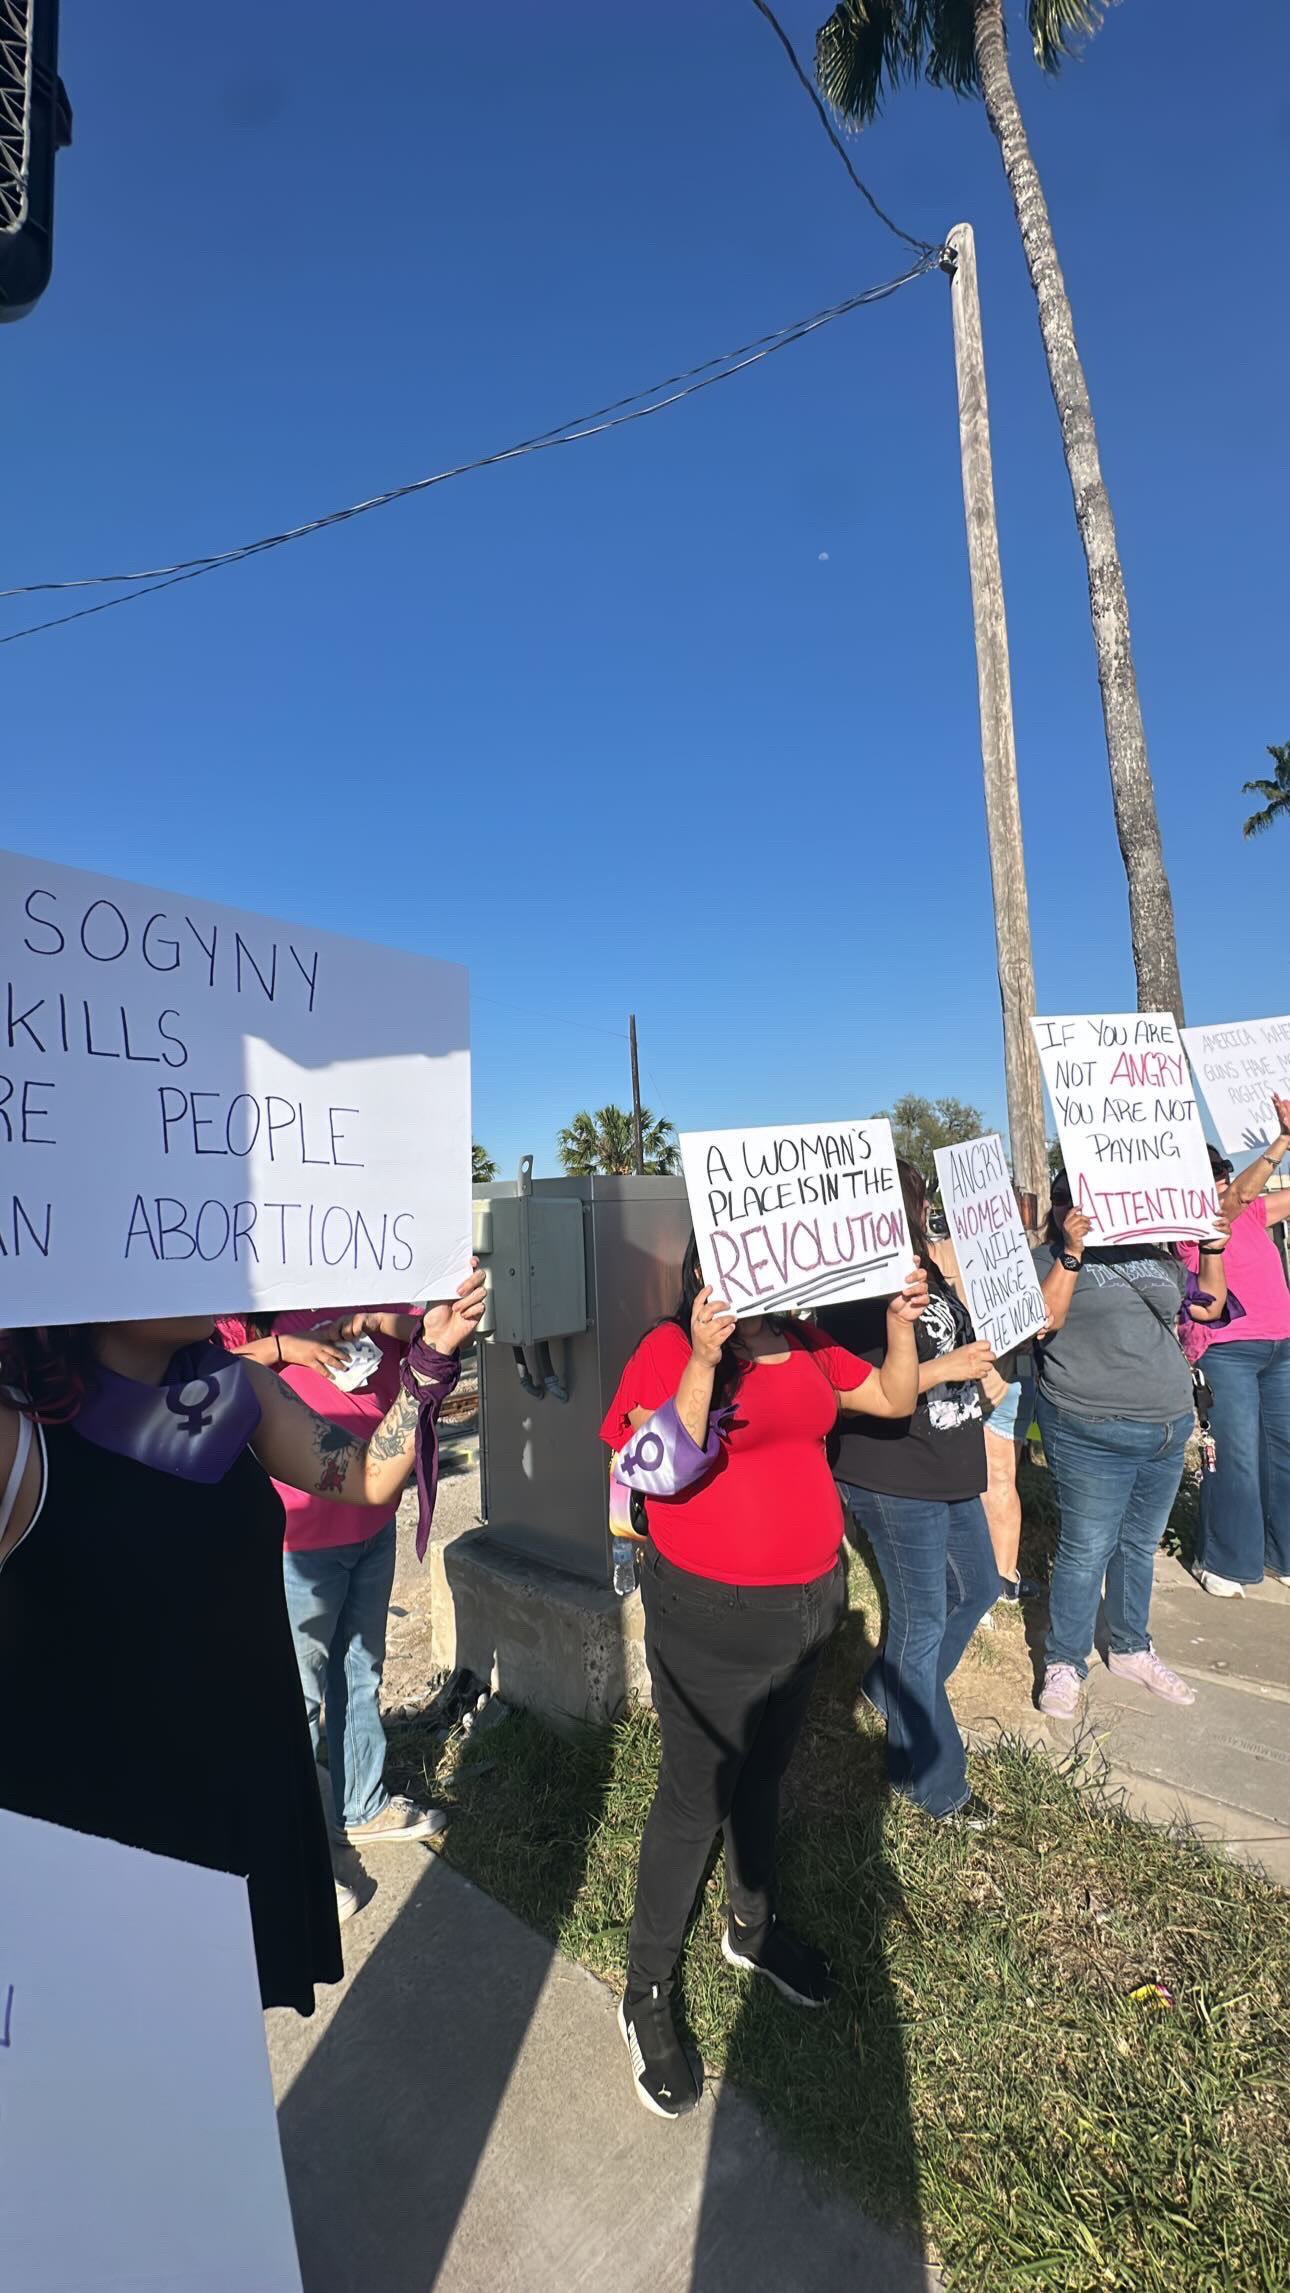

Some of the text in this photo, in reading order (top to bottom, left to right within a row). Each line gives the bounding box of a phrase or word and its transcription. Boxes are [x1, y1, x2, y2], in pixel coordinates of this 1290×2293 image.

[7, 982, 188, 1067] KILLS
[1036, 1019, 1174, 1050] IF YOU ARE
[1056, 1051, 1183, 1089] NOT ANGRY
[1204, 1061, 1239, 1082] GUNS
[1240, 1056, 1275, 1077] HAVE
[158, 1087, 365, 1168] PEOPLE
[1056, 1096, 1196, 1127] YOU ARE NOT
[706, 1128, 872, 1185] A WOMAN'S
[950, 1139, 1005, 1203] ANGRY
[1086, 1131, 1181, 1164] PAYING
[708, 1183, 795, 1227] PLACE
[842, 1167, 895, 1199] THE
[952, 1189, 1014, 1240] WOMEN
[1077, 1172, 1217, 1232] ATTENTION
[124, 1194, 416, 1272] ABORTIONS
[709, 1208, 906, 1303] REVOLUTION
[970, 1260, 1028, 1320] CHANGE
[978, 1312, 1012, 1352] THE
